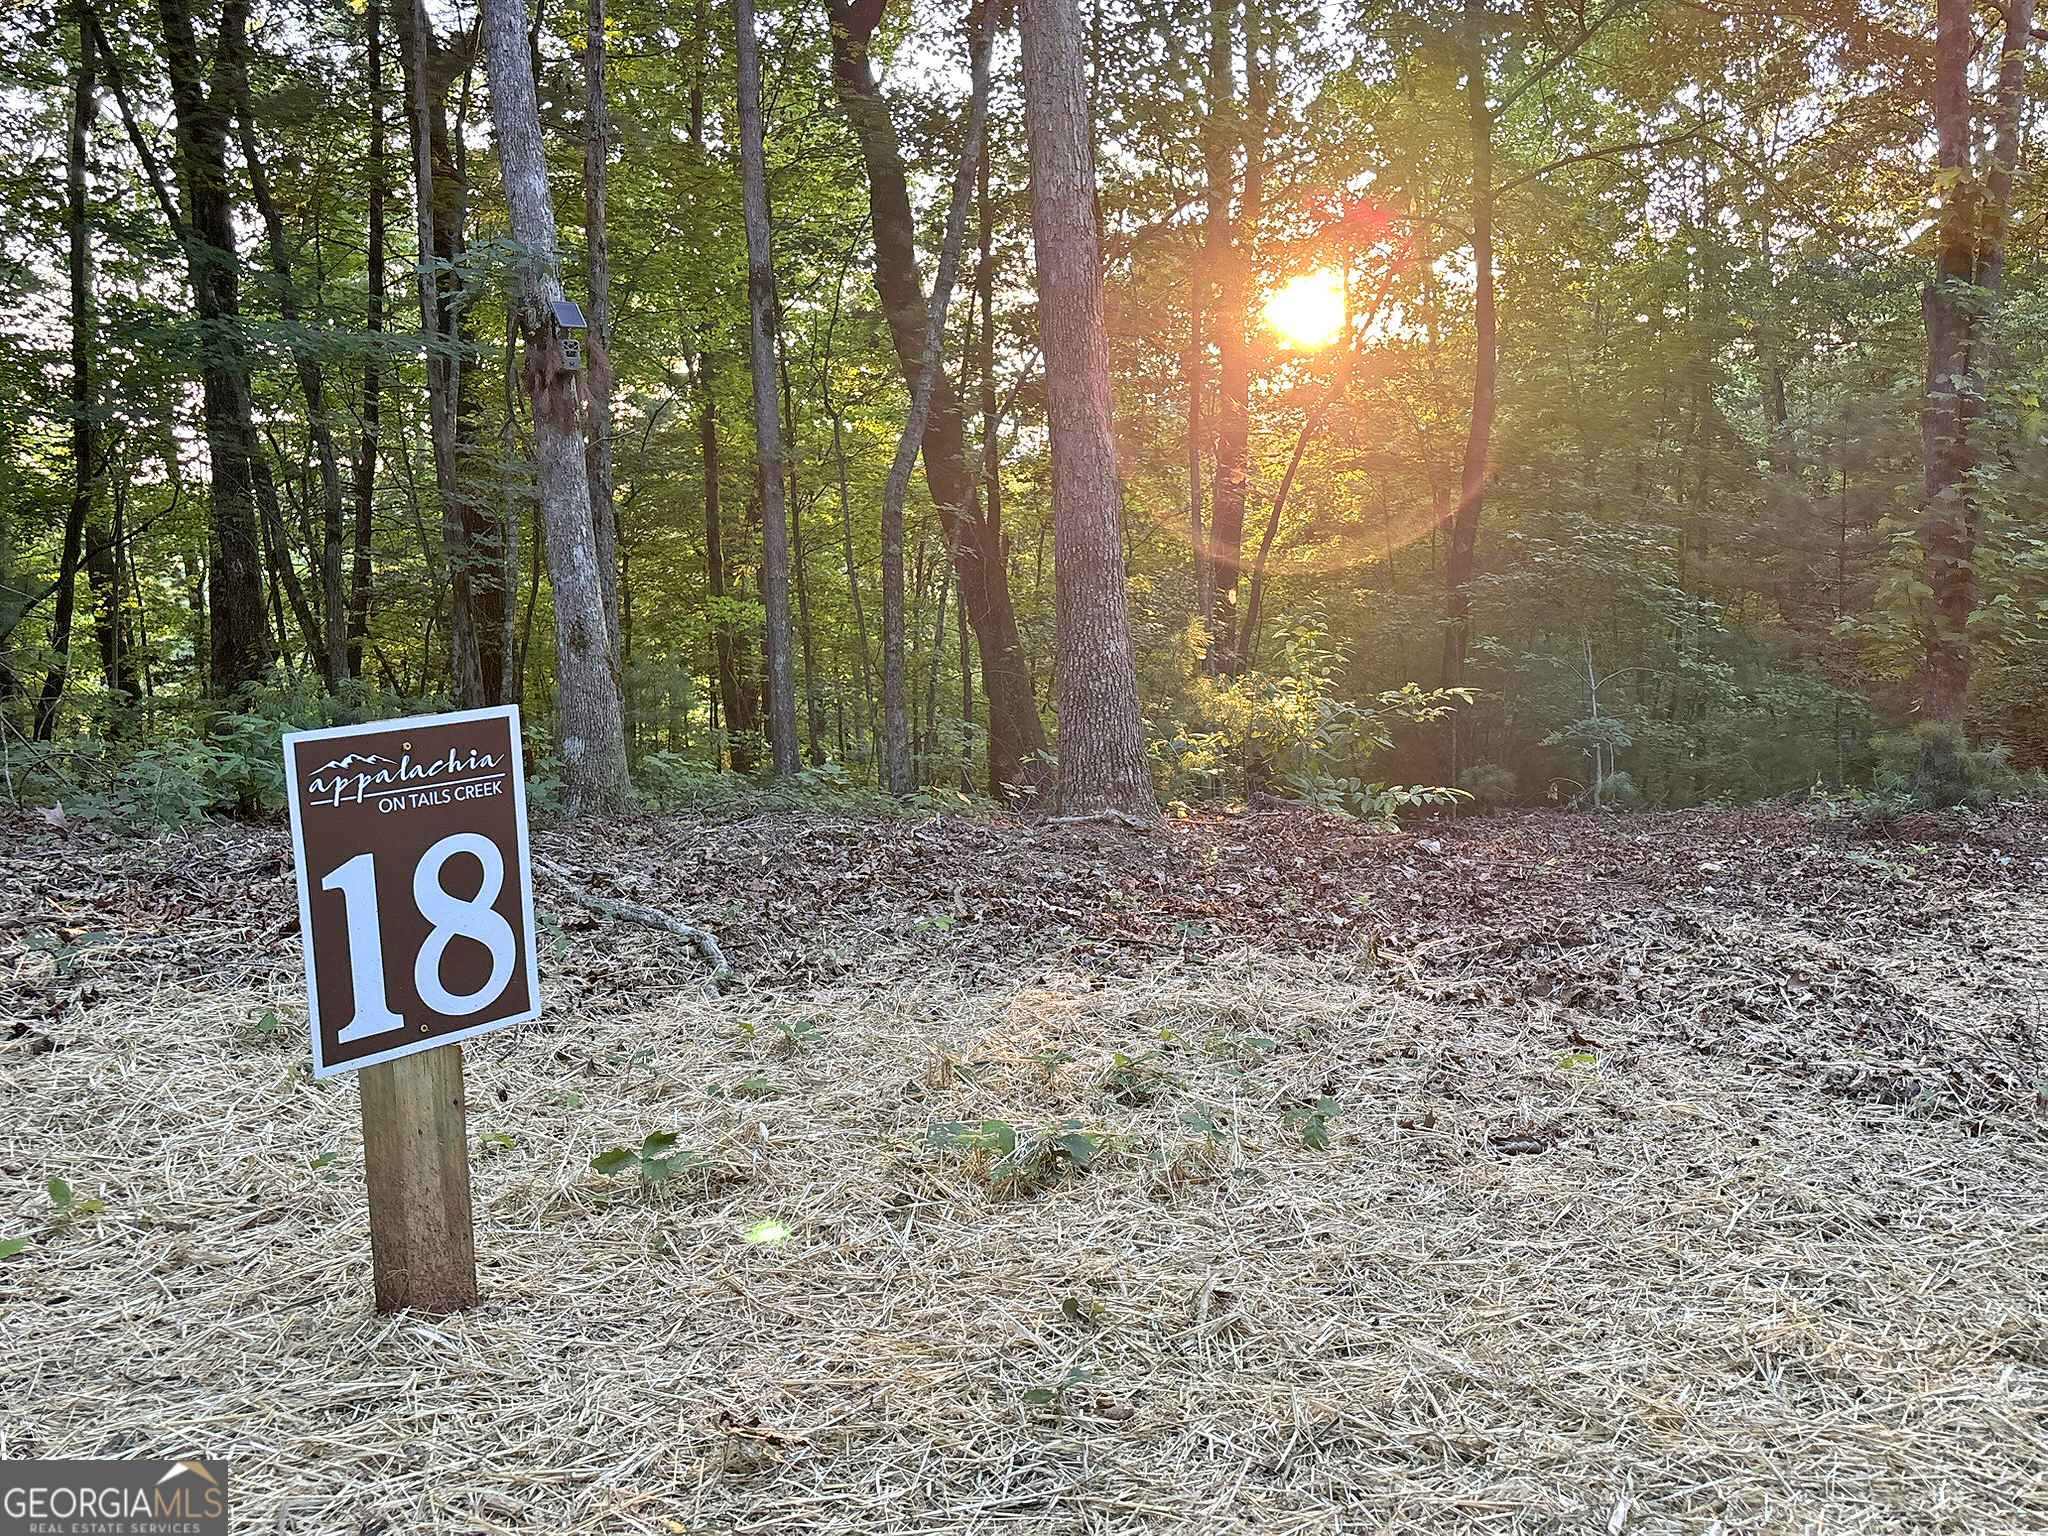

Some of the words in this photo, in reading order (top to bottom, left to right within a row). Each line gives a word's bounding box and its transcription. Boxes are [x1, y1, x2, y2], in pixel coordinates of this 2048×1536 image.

[308, 747, 505, 807] appalachia
[378, 796, 406, 814] ON
[408, 788, 451, 809] TAILS
[454, 780, 503, 801] CREEK
[321, 832, 516, 1045] 18
